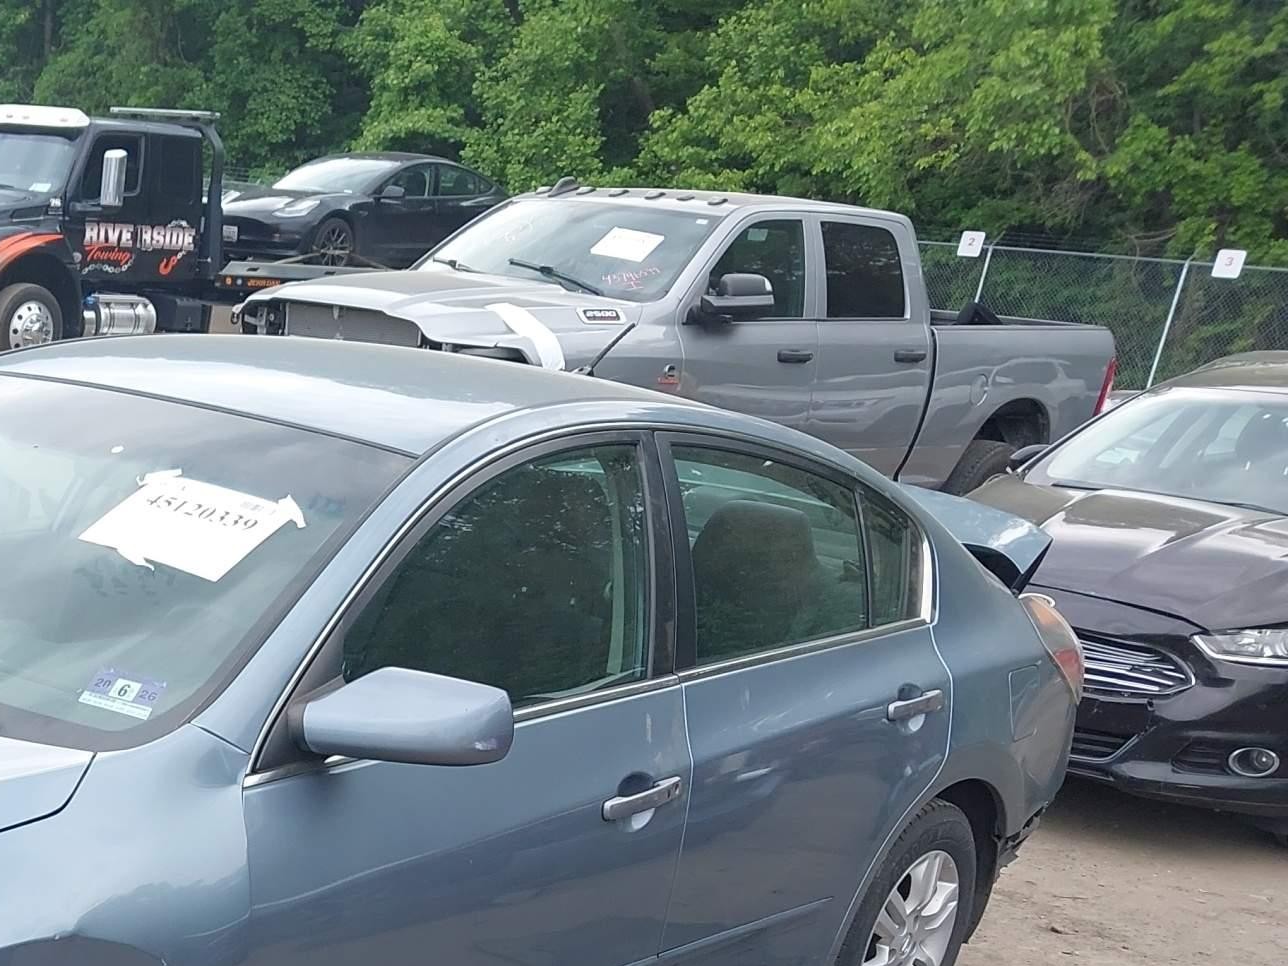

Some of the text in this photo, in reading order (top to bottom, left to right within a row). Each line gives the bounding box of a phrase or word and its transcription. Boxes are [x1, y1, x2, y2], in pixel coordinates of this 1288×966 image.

[85, 243, 132, 265] Towing
[146, 494, 259, 531] 45120339
[117, 683, 131, 697] 6
[139, 689, 159, 701] 26
